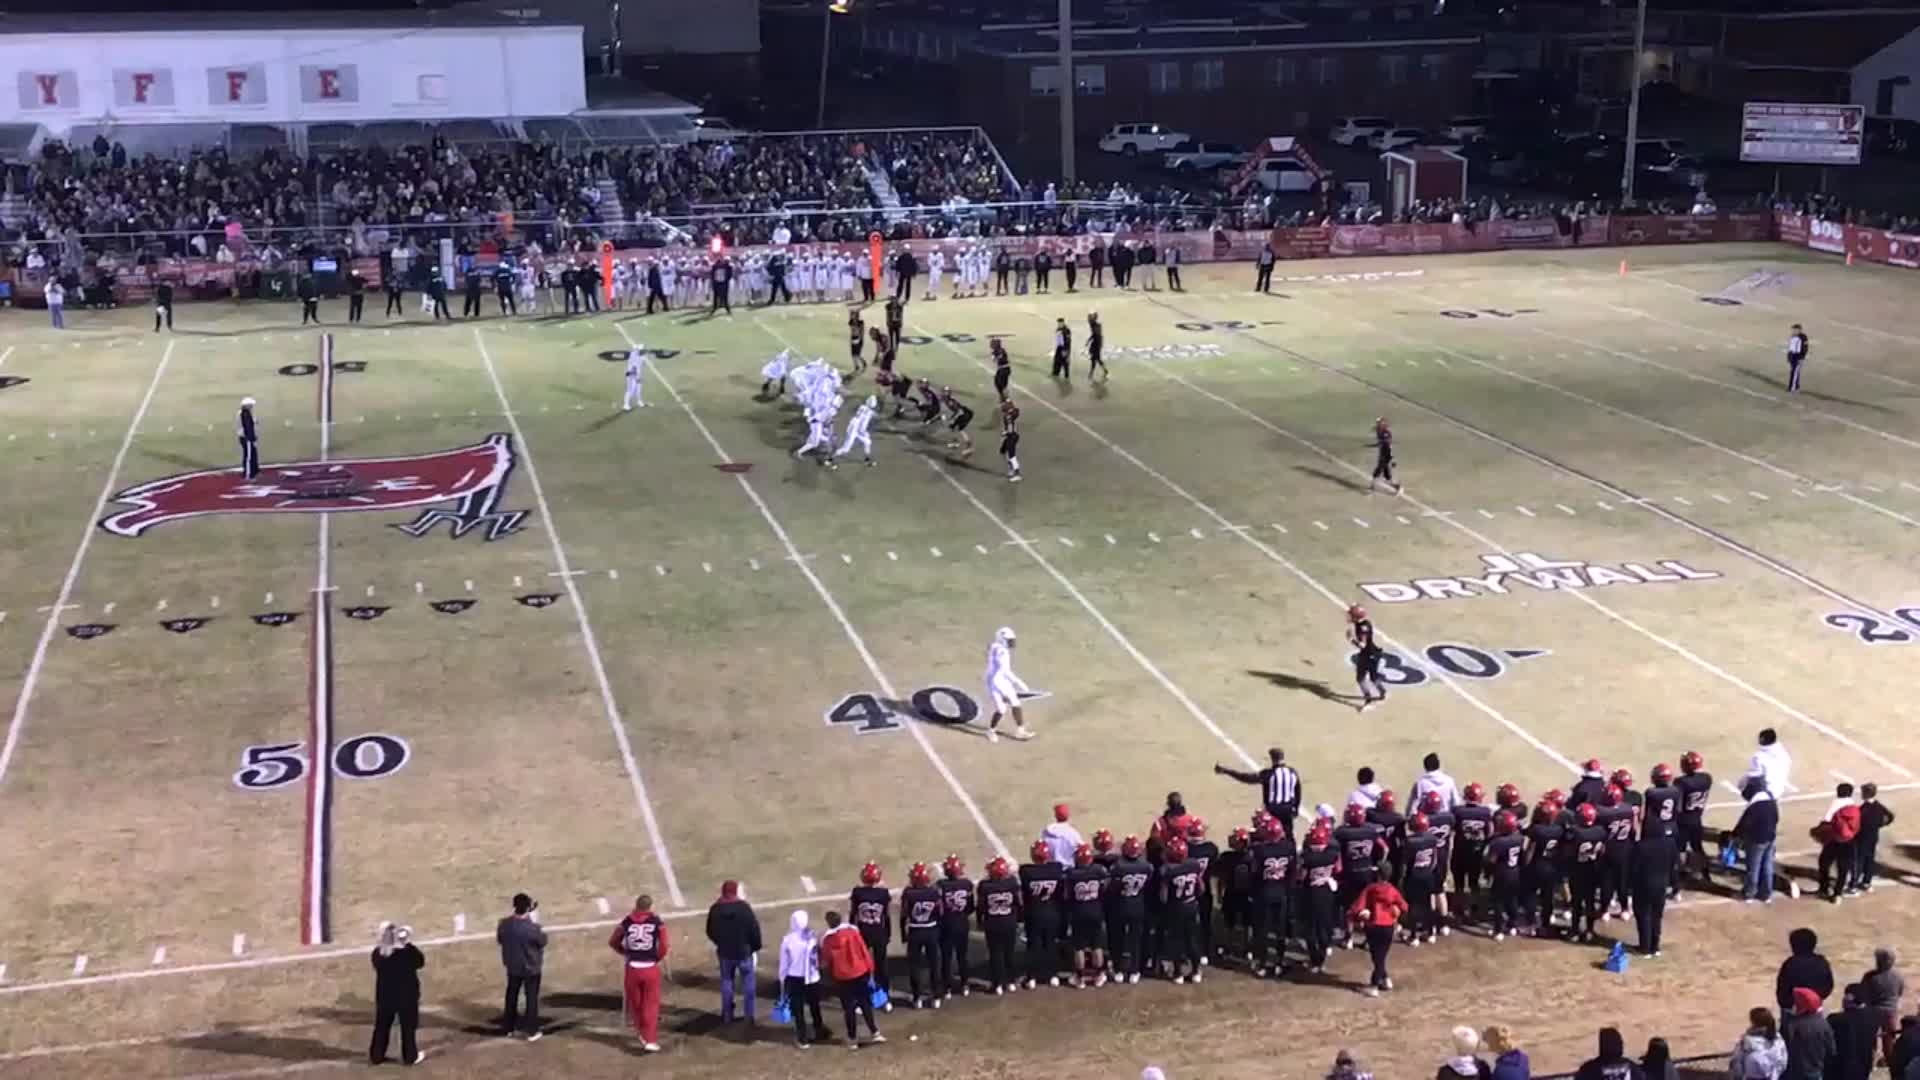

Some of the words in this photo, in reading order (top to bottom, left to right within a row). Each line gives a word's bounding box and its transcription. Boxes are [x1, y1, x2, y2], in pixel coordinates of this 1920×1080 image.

[1357, 560, 1722, 602] DRYWALL
[826, 686, 981, 733] 40
[234, 733, 409, 789] 50
[1029, 879, 1058, 901] 77
[627, 923, 655, 951] 25
